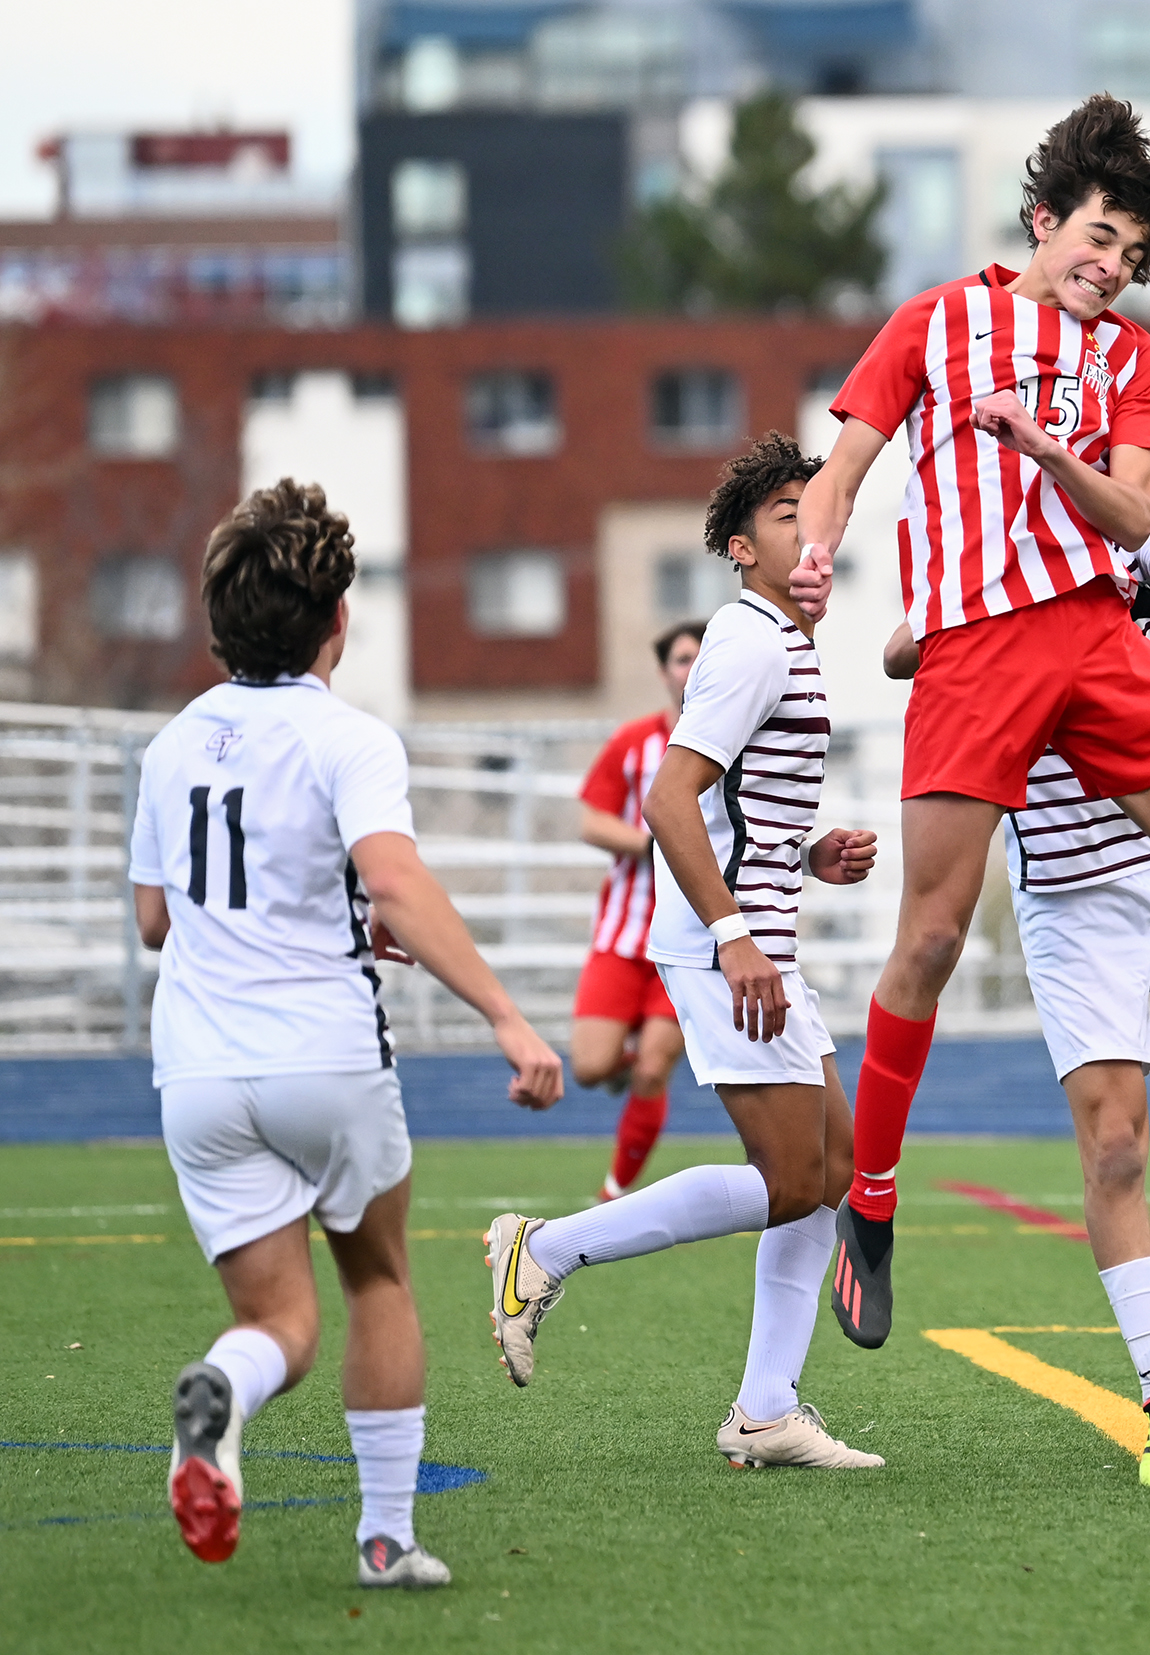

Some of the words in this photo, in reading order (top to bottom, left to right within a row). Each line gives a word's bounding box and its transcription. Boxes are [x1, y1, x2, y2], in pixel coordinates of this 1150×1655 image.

[1020, 375, 1083, 436] 15
[1086, 364, 1110, 387] EAST
[187, 786, 247, 909] 11
